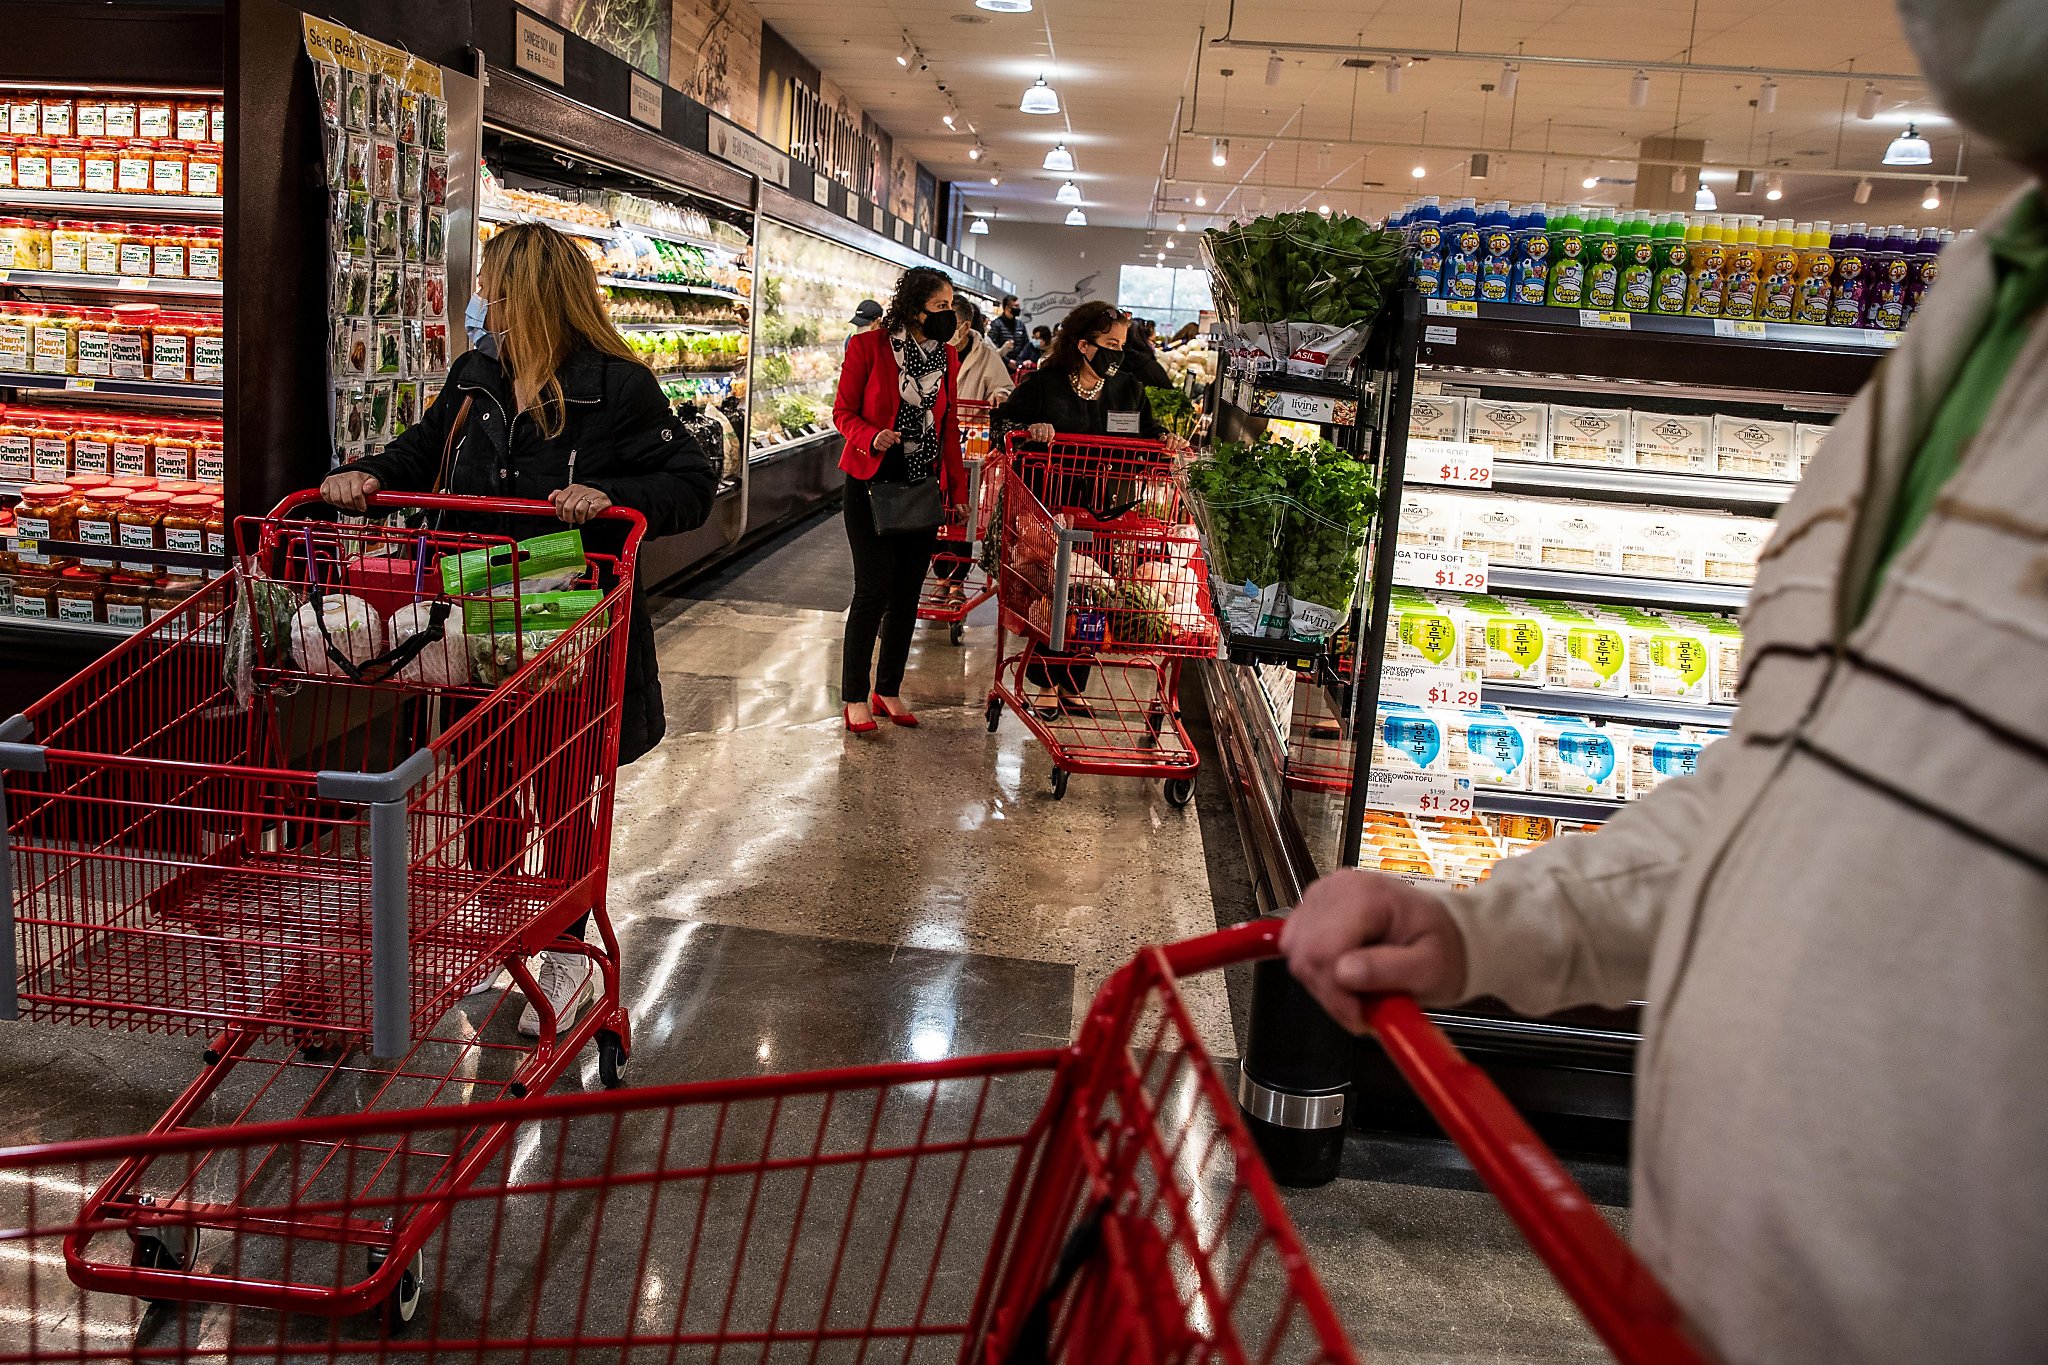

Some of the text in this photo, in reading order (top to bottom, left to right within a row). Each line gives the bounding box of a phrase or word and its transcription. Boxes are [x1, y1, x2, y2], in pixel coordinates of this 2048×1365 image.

[335, 38, 355, 58] Bee
[36, 337, 60, 346] Cham
[80, 341, 103, 350] Cham
[36, 346, 64, 355] Kimchi
[112, 344, 136, 352] Cham
[155, 345, 178, 354] Cham
[196, 346, 219, 355] Cham
[80, 349, 108, 358] Kimchi
[112, 352, 141, 361] Kimchi
[155, 354, 184, 362] Kimchi
[196, 355, 223, 364] Kimchi
[1292, 398, 1318, 412] living
[1413, 408, 1433, 416] JINGA
[1496, 412, 1516, 421] JINGA
[1662, 427, 1682, 435] JINGA
[1744, 432, 1764, 440] JINGA
[0, 445, 23, 454] Cham
[36, 448, 60, 457] Cham
[0, 454, 29, 462] Kimchi
[76, 450, 100, 459] Cham
[116, 452, 138, 461] Cham
[36, 457, 64, 466] Kimchi
[76, 458, 105, 468] Kimchi
[116, 461, 143, 470] Kimchi
[156, 457, 180, 466] Cham
[156, 465, 186, 474] Kimchi
[197, 467, 224, 476] Kimch
[1440, 464, 1490, 482] $1.29
[1489, 515, 1509, 523] JINGA
[1569, 522, 1589, 530] JINGA
[18, 527, 42, 538] Cham
[80, 530, 104, 540] Cham
[122, 534, 146, 545] Cham
[168, 538, 194, 548] Cham
[1414, 552, 1438, 561] TOFU
[1440, 554, 1464, 563] SOFT
[1434, 570, 1485, 588] $1.29
[16, 605, 40, 616] Cham
[60, 608, 86, 618] Cham
[1300, 609, 1338, 632] living
[1382, 664, 1426, 674] OONYEOWON
[1428, 686, 1478, 706] $1.29
[1420, 793, 1470, 813] $1.29
